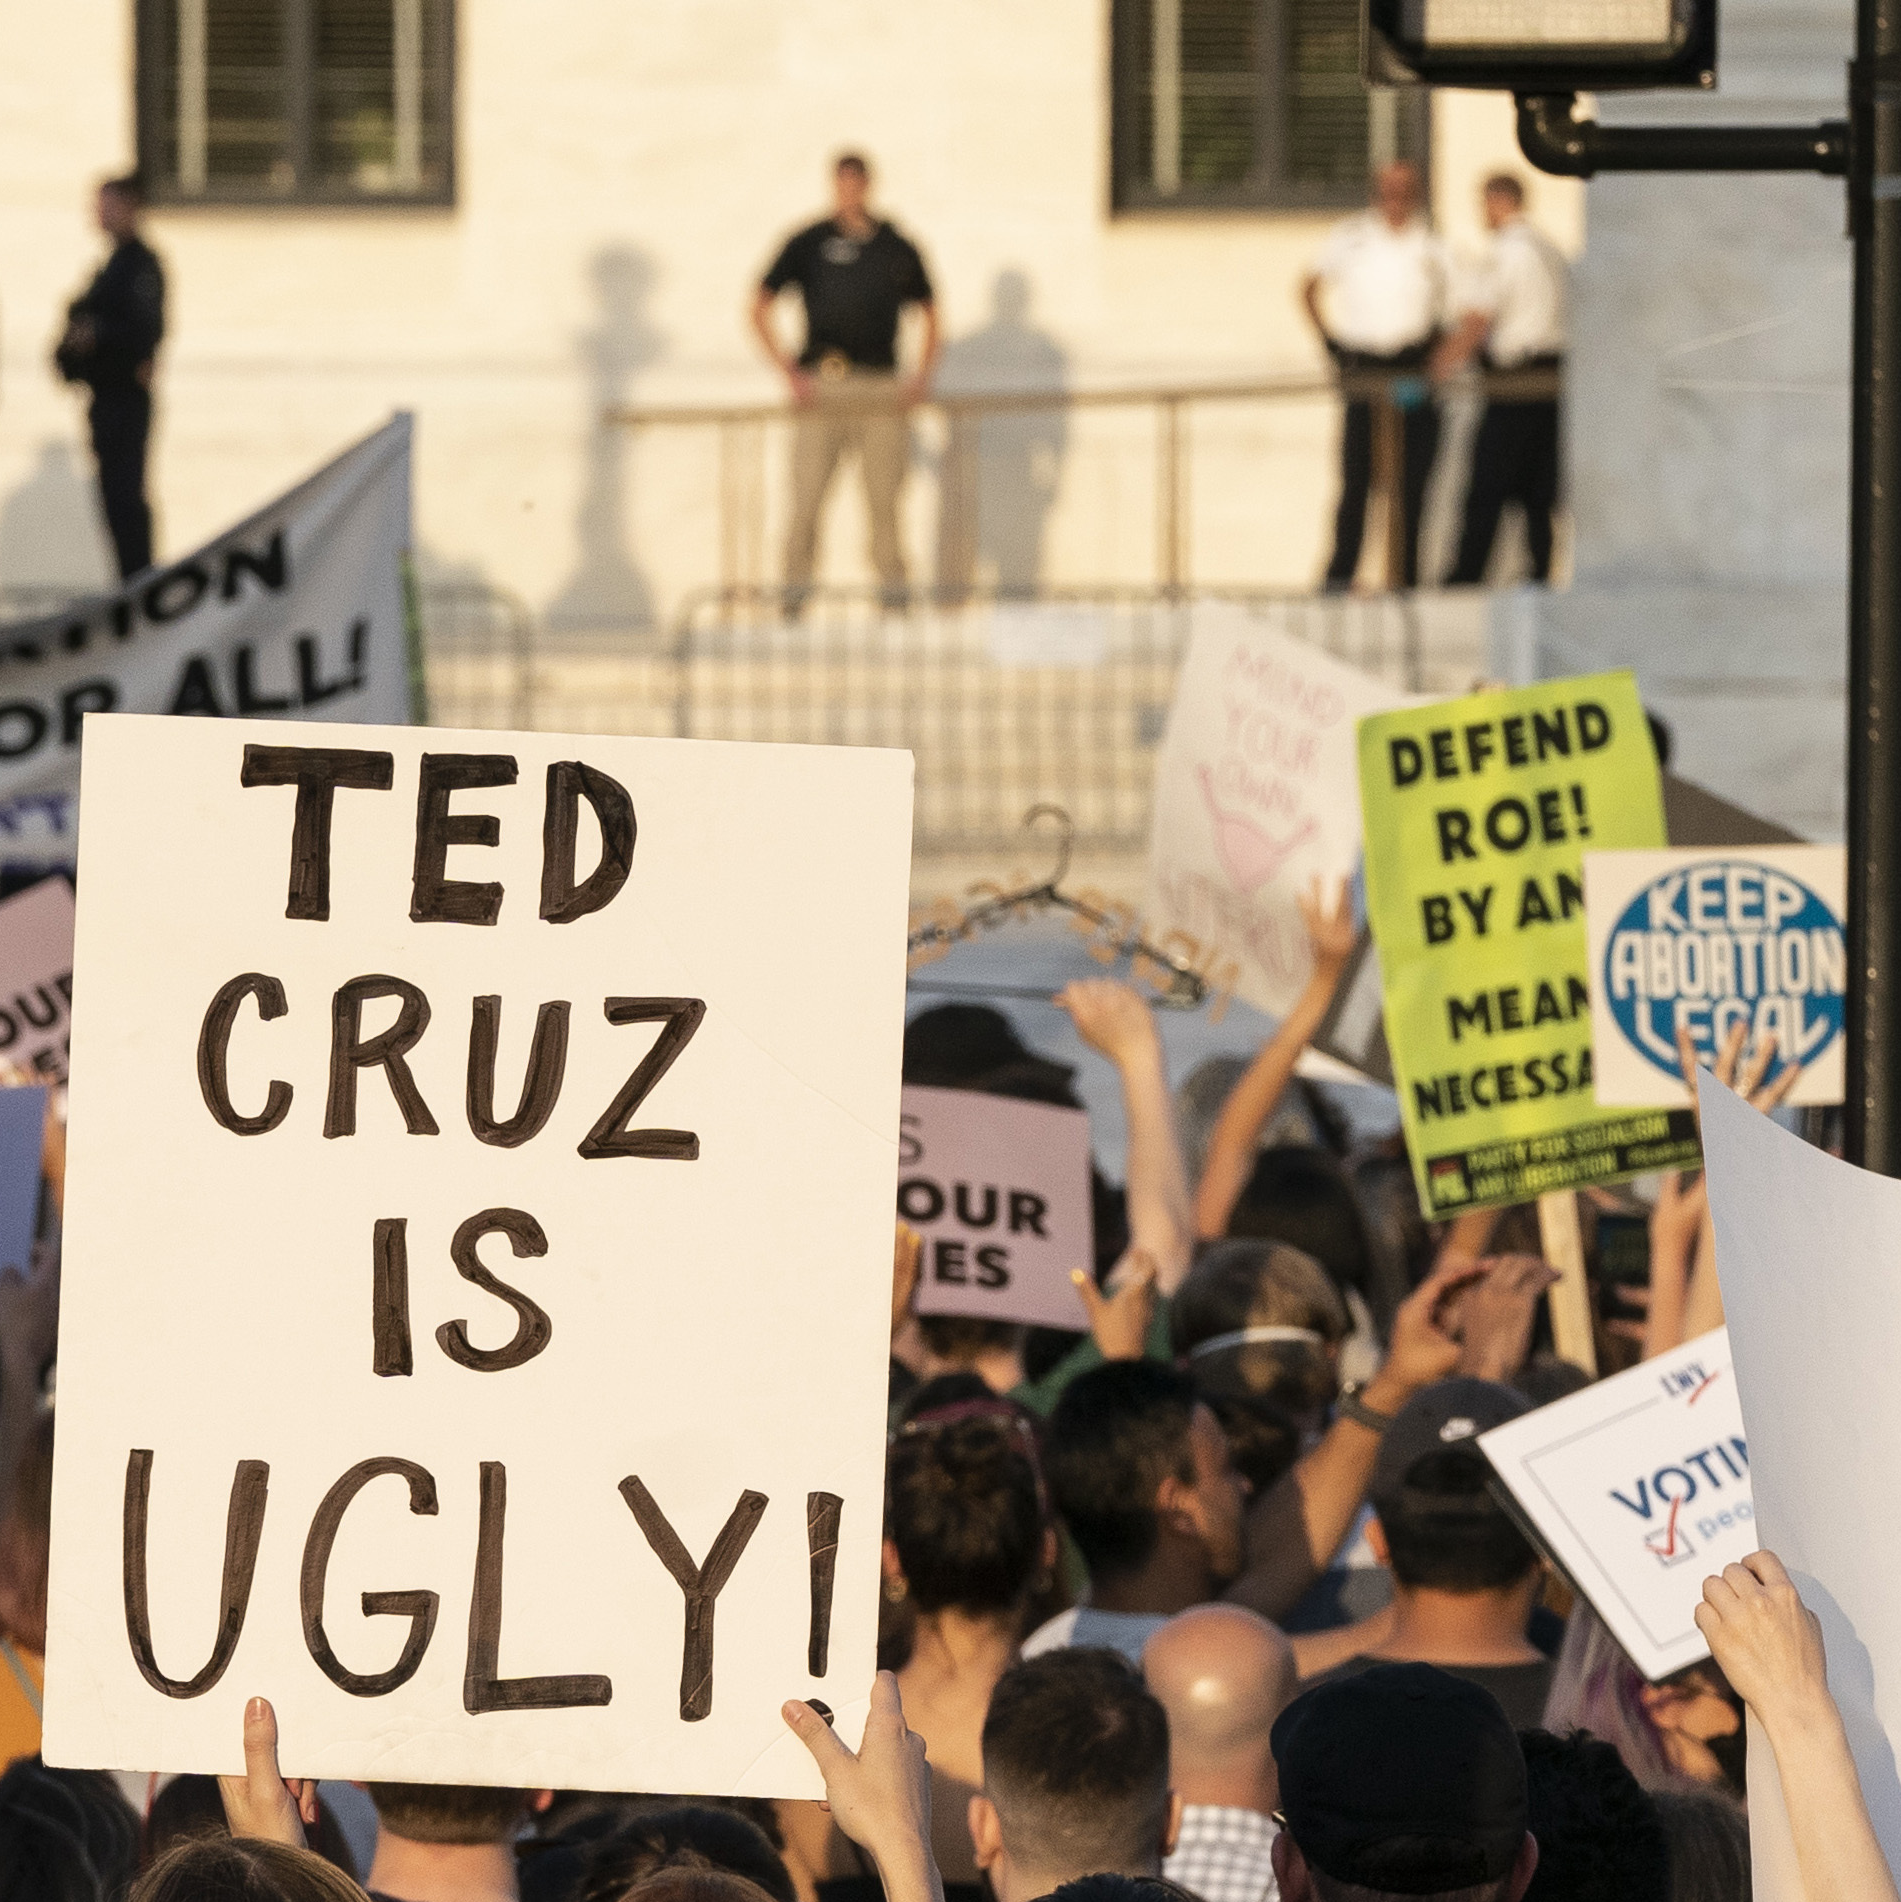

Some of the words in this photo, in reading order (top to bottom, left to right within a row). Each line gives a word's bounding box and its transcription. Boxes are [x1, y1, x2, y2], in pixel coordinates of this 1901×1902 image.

[170, 614, 369, 718] ALL!
[1388, 701, 1613, 789] DEFEND
[241, 743, 638, 925] TED
[1435, 785, 1594, 865] ROE!
[1420, 884, 1494, 946] BY
[1516, 871, 1586, 930] AN
[1649, 867, 1806, 932] KEEP
[1609, 928, 1846, 1001] ABORTION
[1446, 974, 1591, 1043] MEAN
[197, 972, 707, 1161] CRUZ
[898, 1176, 1049, 1240] OUR
[372, 1207, 552, 1378] IS
[1695, 1501, 1755, 1542] peo
[122, 1447, 845, 1727] UGLY!
